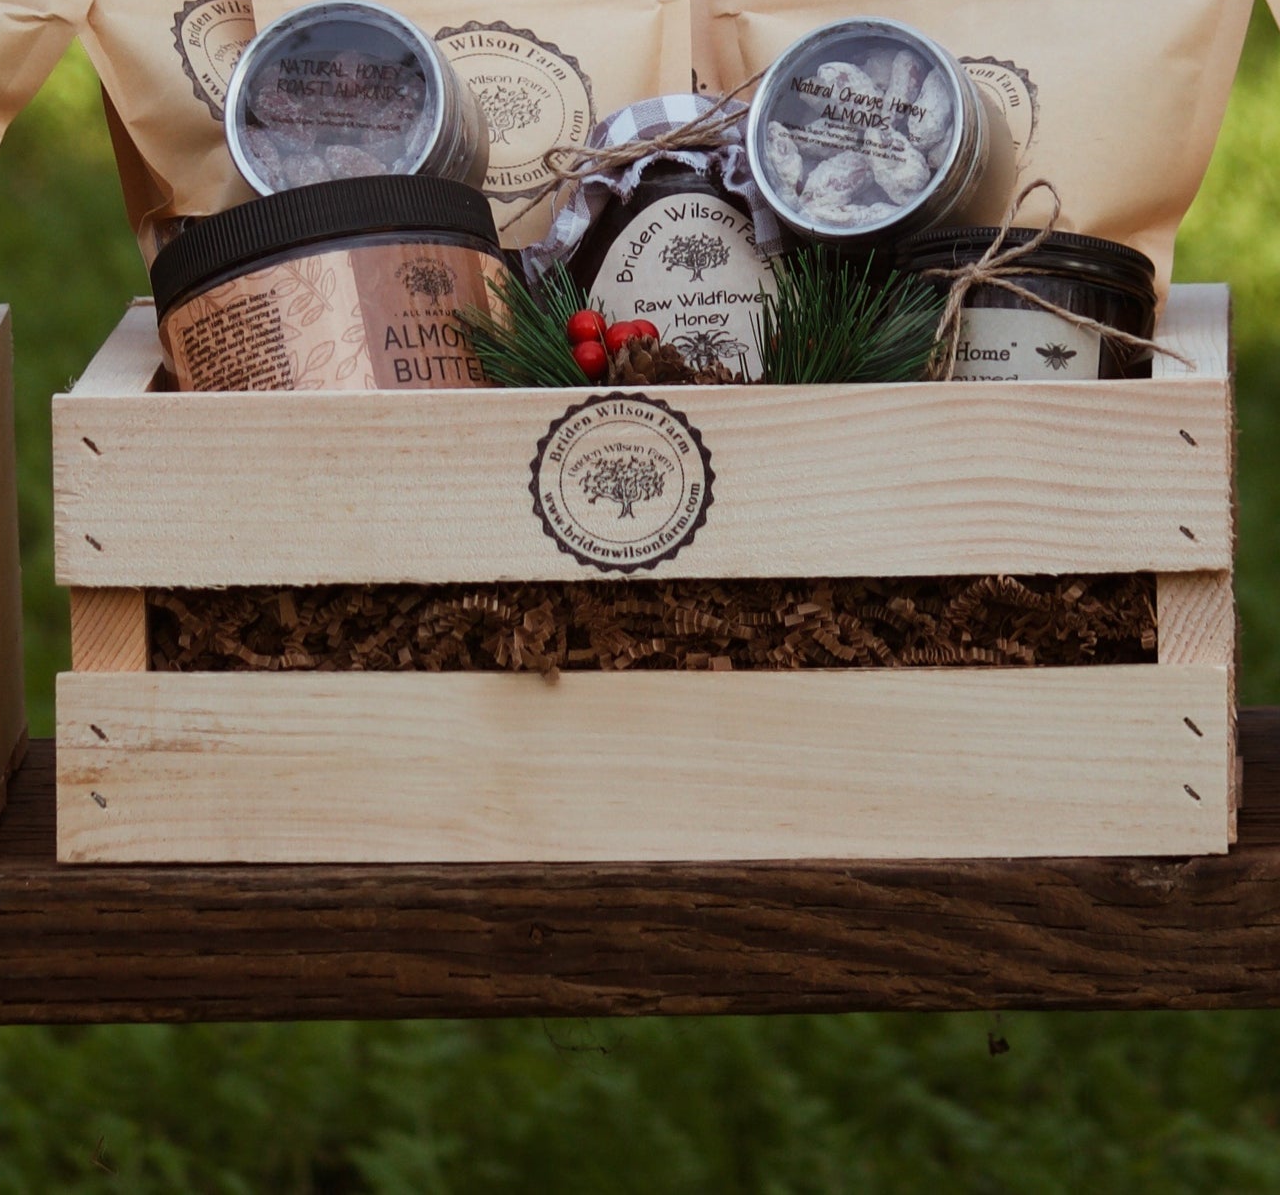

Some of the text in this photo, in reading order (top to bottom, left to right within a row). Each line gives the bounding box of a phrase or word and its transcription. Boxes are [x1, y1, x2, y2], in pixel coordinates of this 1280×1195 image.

[189, 0, 251, 48] Briden Wils
[279, 59, 403, 81] NATURAL HONEY
[449, 34, 567, 82] Wilson Farm
[276, 78, 407, 101] ROAST ALMONDS
[790, 76, 928, 123] Natural Orange Honey
[996, 73, 1022, 108] Farm
[821, 104, 891, 131] ALMONDS
[616, 202, 774, 283] Briden Wilson Fam
[403, 309, 421, 317] ALL
[635, 290, 772, 315] Raw Wildflower
[674, 312, 730, 328] Honey
[385, 323, 467, 351] ALMO
[549, 403, 691, 463] Briden Wilson Farm
[544, 482, 701, 559] www.bridenwilsonfarm.com
